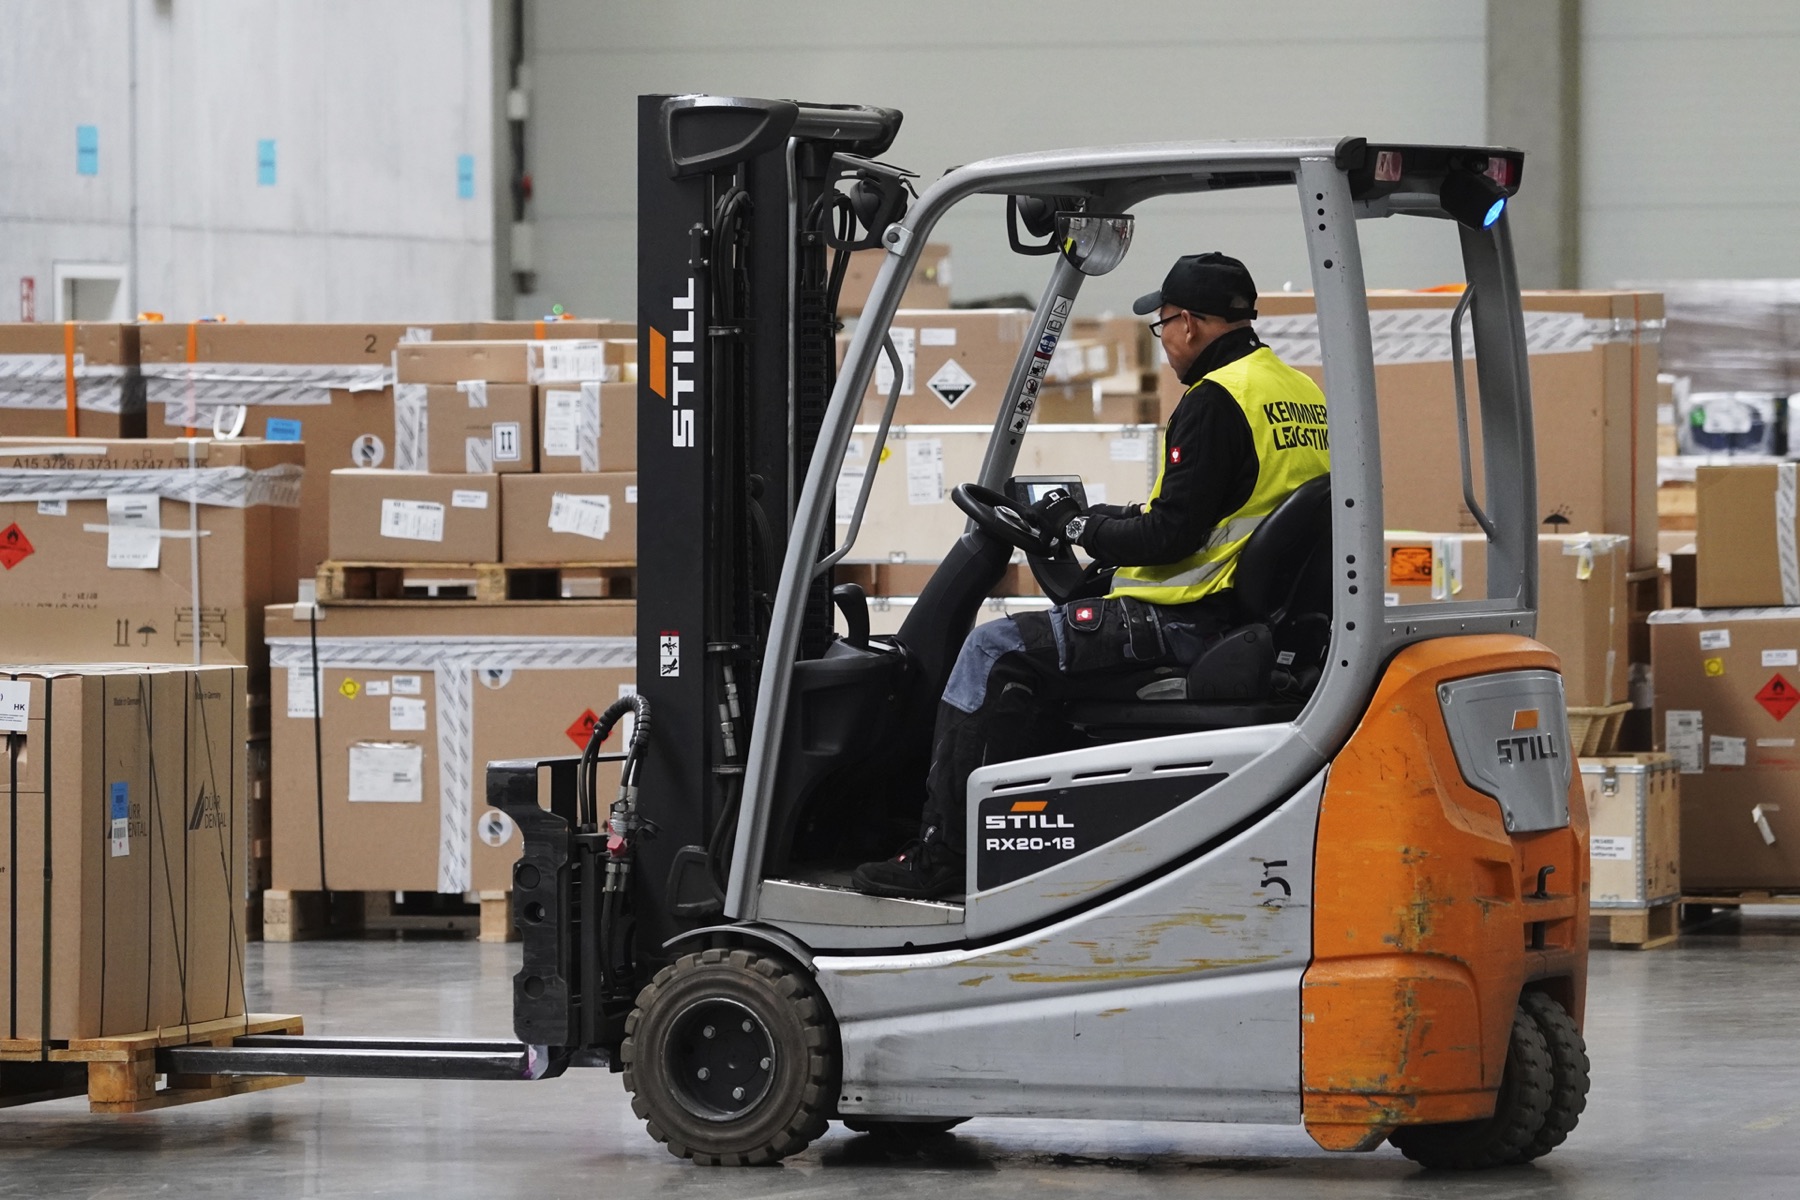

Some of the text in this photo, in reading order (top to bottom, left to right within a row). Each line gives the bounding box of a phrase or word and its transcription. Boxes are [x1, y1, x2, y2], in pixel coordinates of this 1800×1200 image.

[364, 333, 377, 354] 2
[672, 277, 695, 448] STILL
[1263, 401, 1328, 425] KEMMNER
[13, 457, 39, 469] A15
[87, 457, 118, 469] 3731
[13, 703, 26, 711] HK
[1495, 732, 1559, 764] STILL
[128, 800, 141, 820] ÜRR
[128, 820, 148, 838] ENTAL
[204, 812, 227, 829] DENTAL
[985, 814, 1075, 829] STILL
[986, 836, 1076, 851] RX20-18
